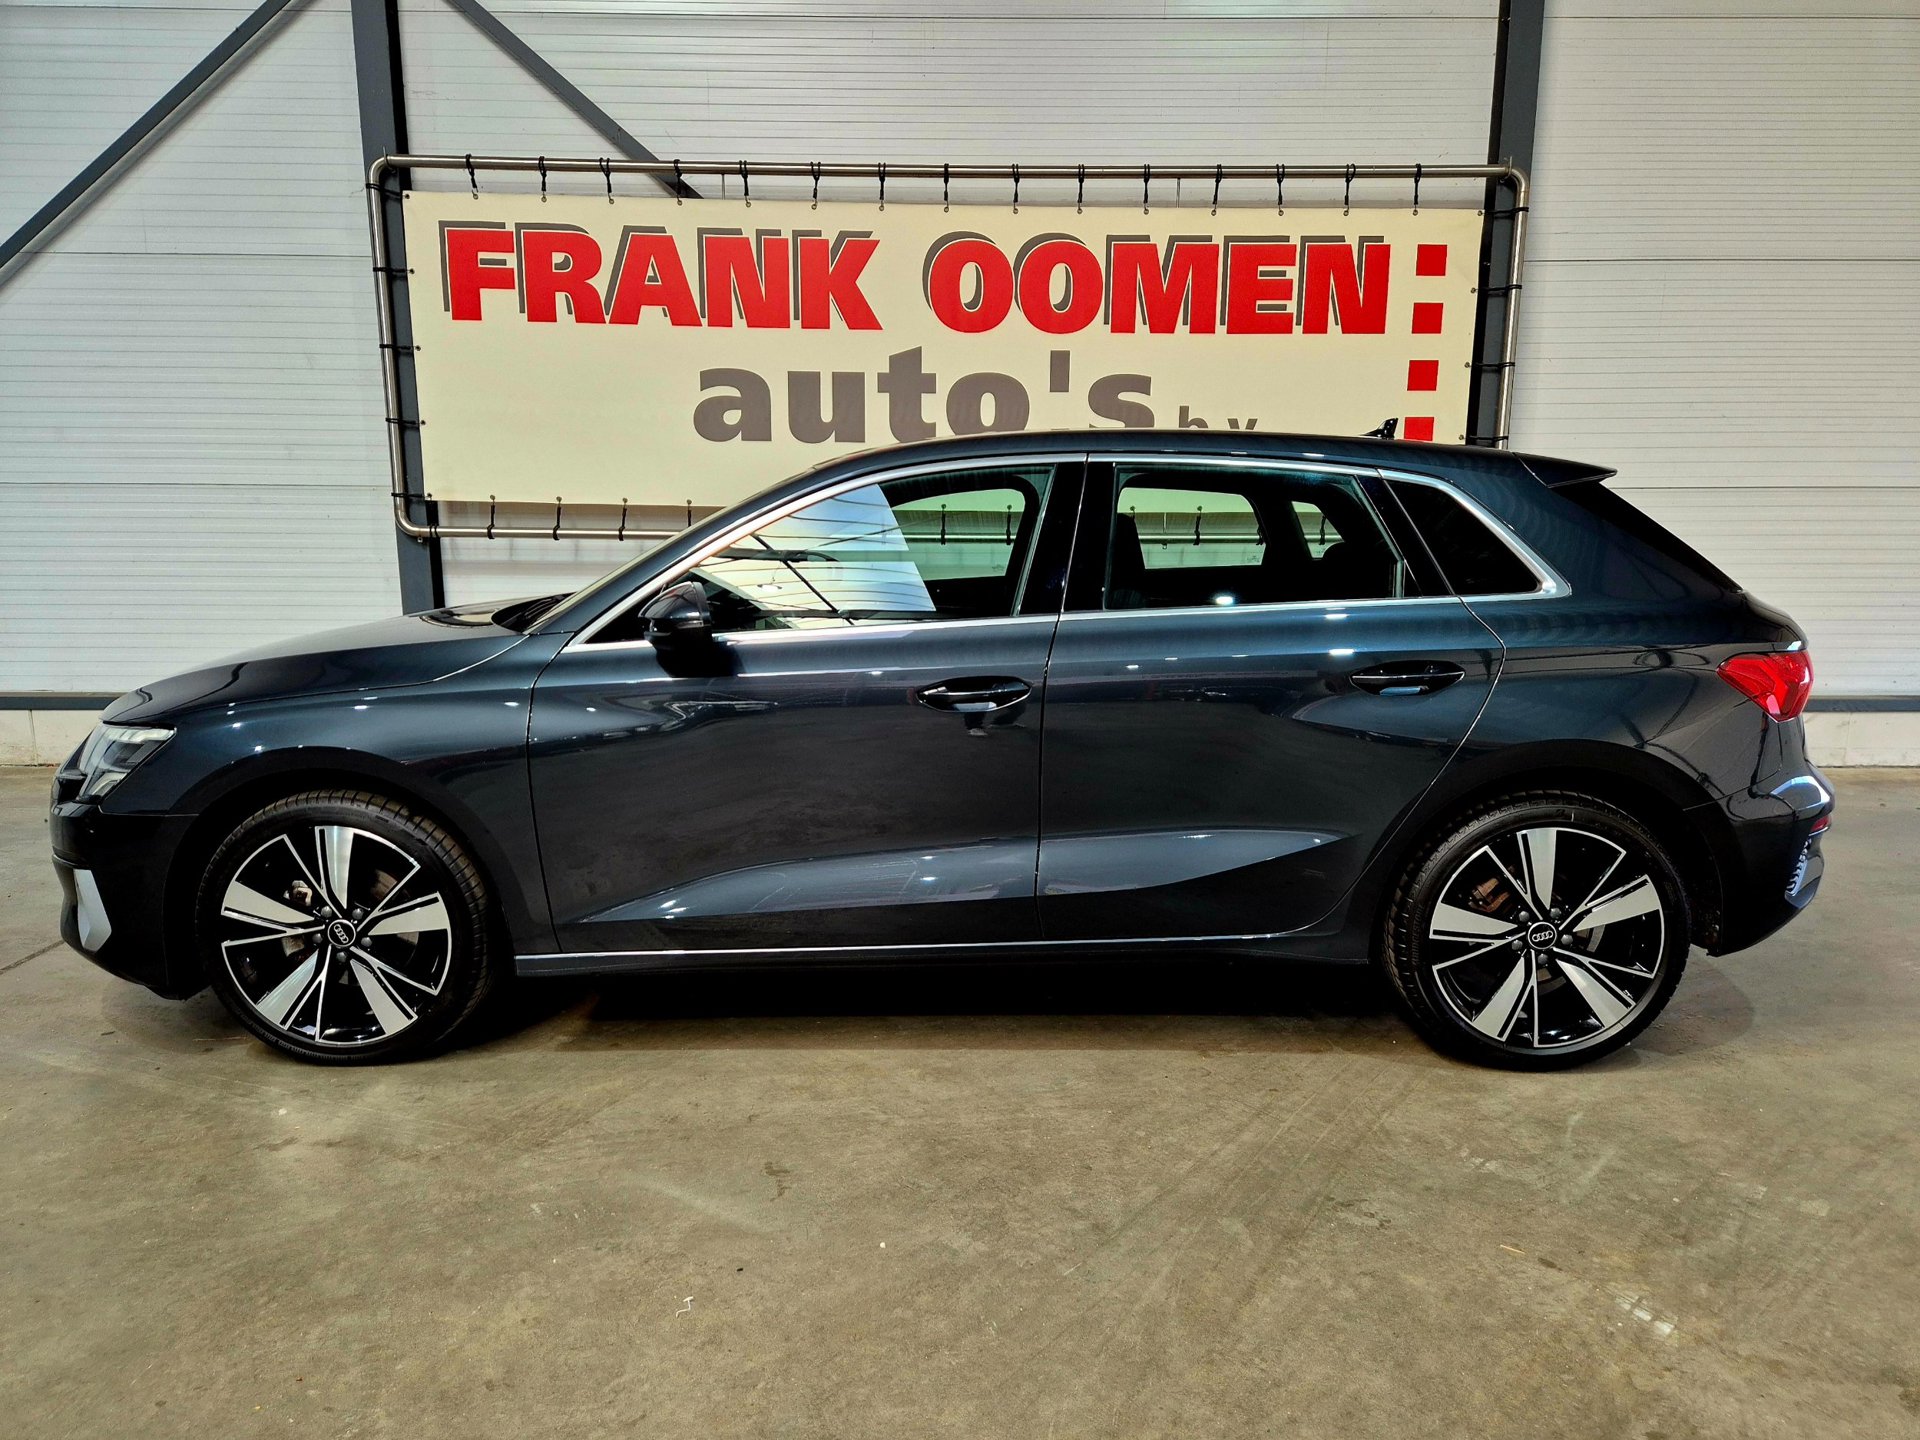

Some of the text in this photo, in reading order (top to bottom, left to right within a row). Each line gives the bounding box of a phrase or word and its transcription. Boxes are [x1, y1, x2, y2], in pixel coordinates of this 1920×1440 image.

[439, 221, 1391, 335] FRANK OOMEN
[692, 345, 1155, 444] auto's
